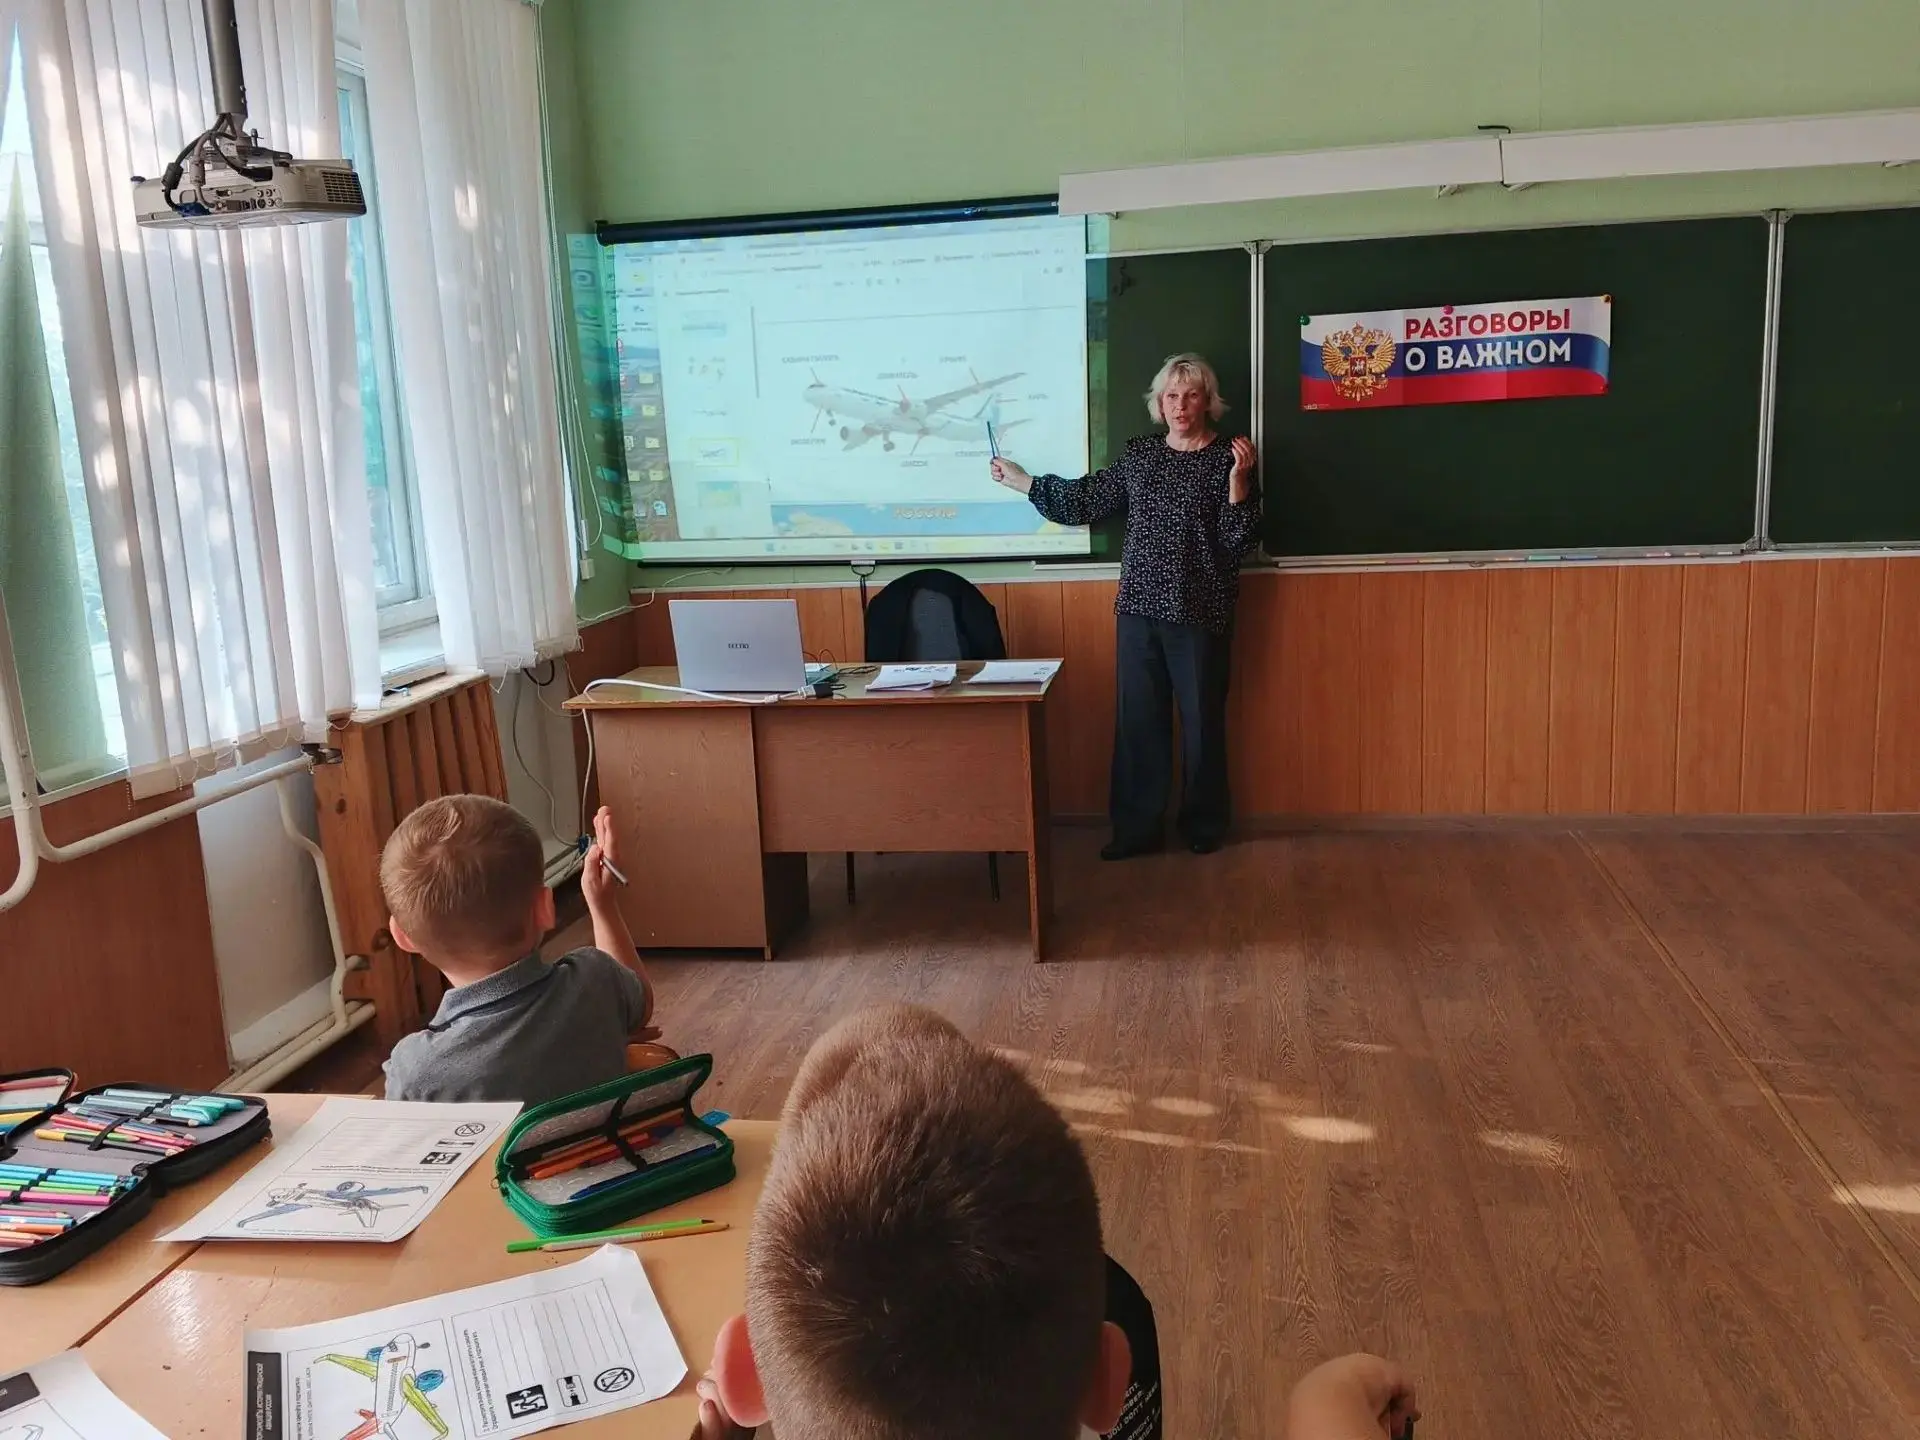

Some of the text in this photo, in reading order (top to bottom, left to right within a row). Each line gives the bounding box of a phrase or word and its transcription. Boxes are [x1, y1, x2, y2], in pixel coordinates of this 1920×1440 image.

[1405, 308, 1571, 340] РАЗГОВОРЫ
[1405, 337, 1572, 371] О ВАЖНОМ
